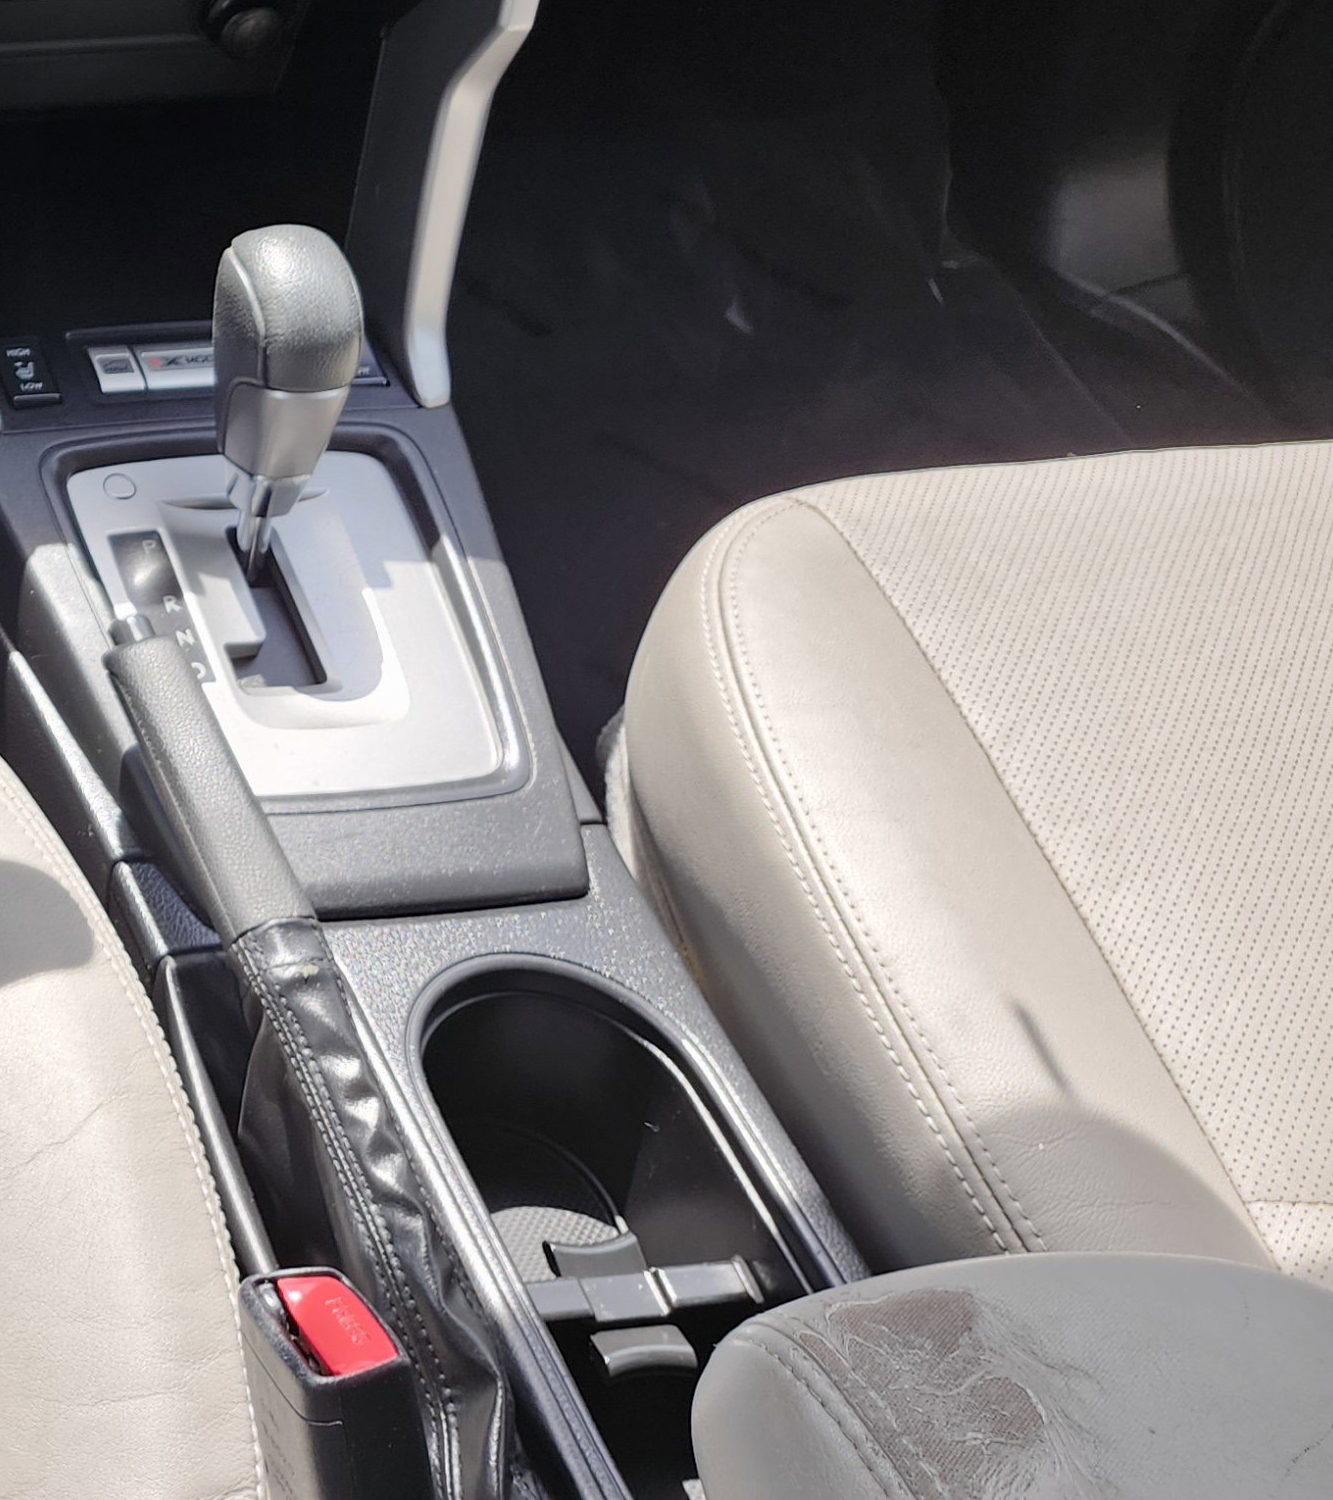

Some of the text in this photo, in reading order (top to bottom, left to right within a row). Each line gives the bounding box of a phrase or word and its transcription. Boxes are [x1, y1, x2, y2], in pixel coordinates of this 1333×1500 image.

[6, 347, 31, 357] HIGH
[19, 381, 44, 391] LOW
[142, 539, 156, 554] P
[162, 595, 182, 613] R
[174, 628, 196, 647] N
